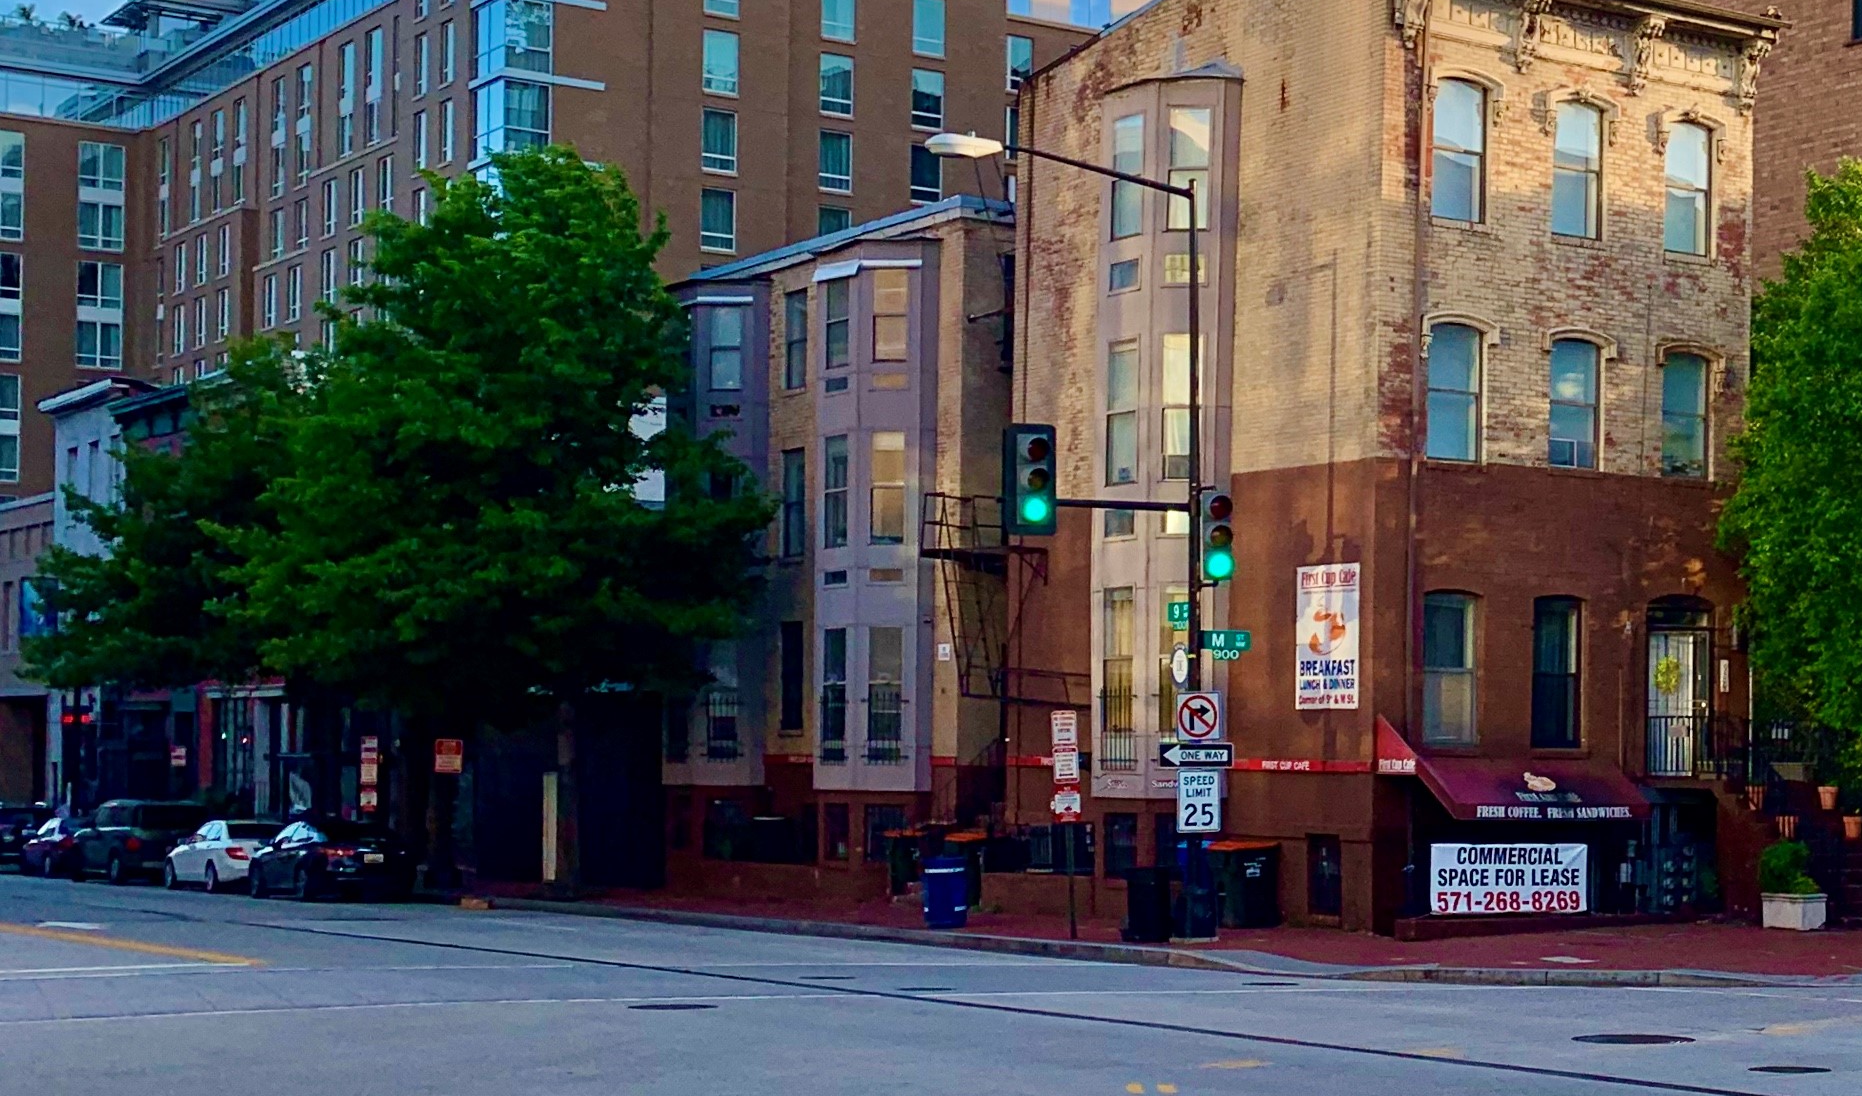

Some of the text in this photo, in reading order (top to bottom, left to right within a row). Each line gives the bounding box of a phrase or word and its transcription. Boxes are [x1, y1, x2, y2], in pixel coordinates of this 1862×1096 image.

[1302, 571, 1319, 586] First
[1321, 571, 1336, 586] Cup
[1173, 604, 1179, 619] 9
[1211, 633, 1225, 647] M
[1213, 650, 1239, 659] 900
[1300, 659, 1355, 677] BREAKFAST
[1300, 679, 1320, 690] LUNCH
[1329, 678, 1355, 690] DINNER
[1181, 751, 1224, 760] ONE WAY
[1279, 760, 1292, 770] CUP
[1183, 776, 1214, 785] SPEED
[1186, 788, 1212, 798] LIMIT
[1184, 803, 1214, 826] 25
[1476, 805, 1505, 818] FRESH
[1547, 807, 1574, 818] FRESH
[1456, 847, 1563, 865] COMMERCIAL
[1437, 868, 1580, 886] SPACE FOR LEASE
[1437, 890, 1580, 912] 571-268-8269
